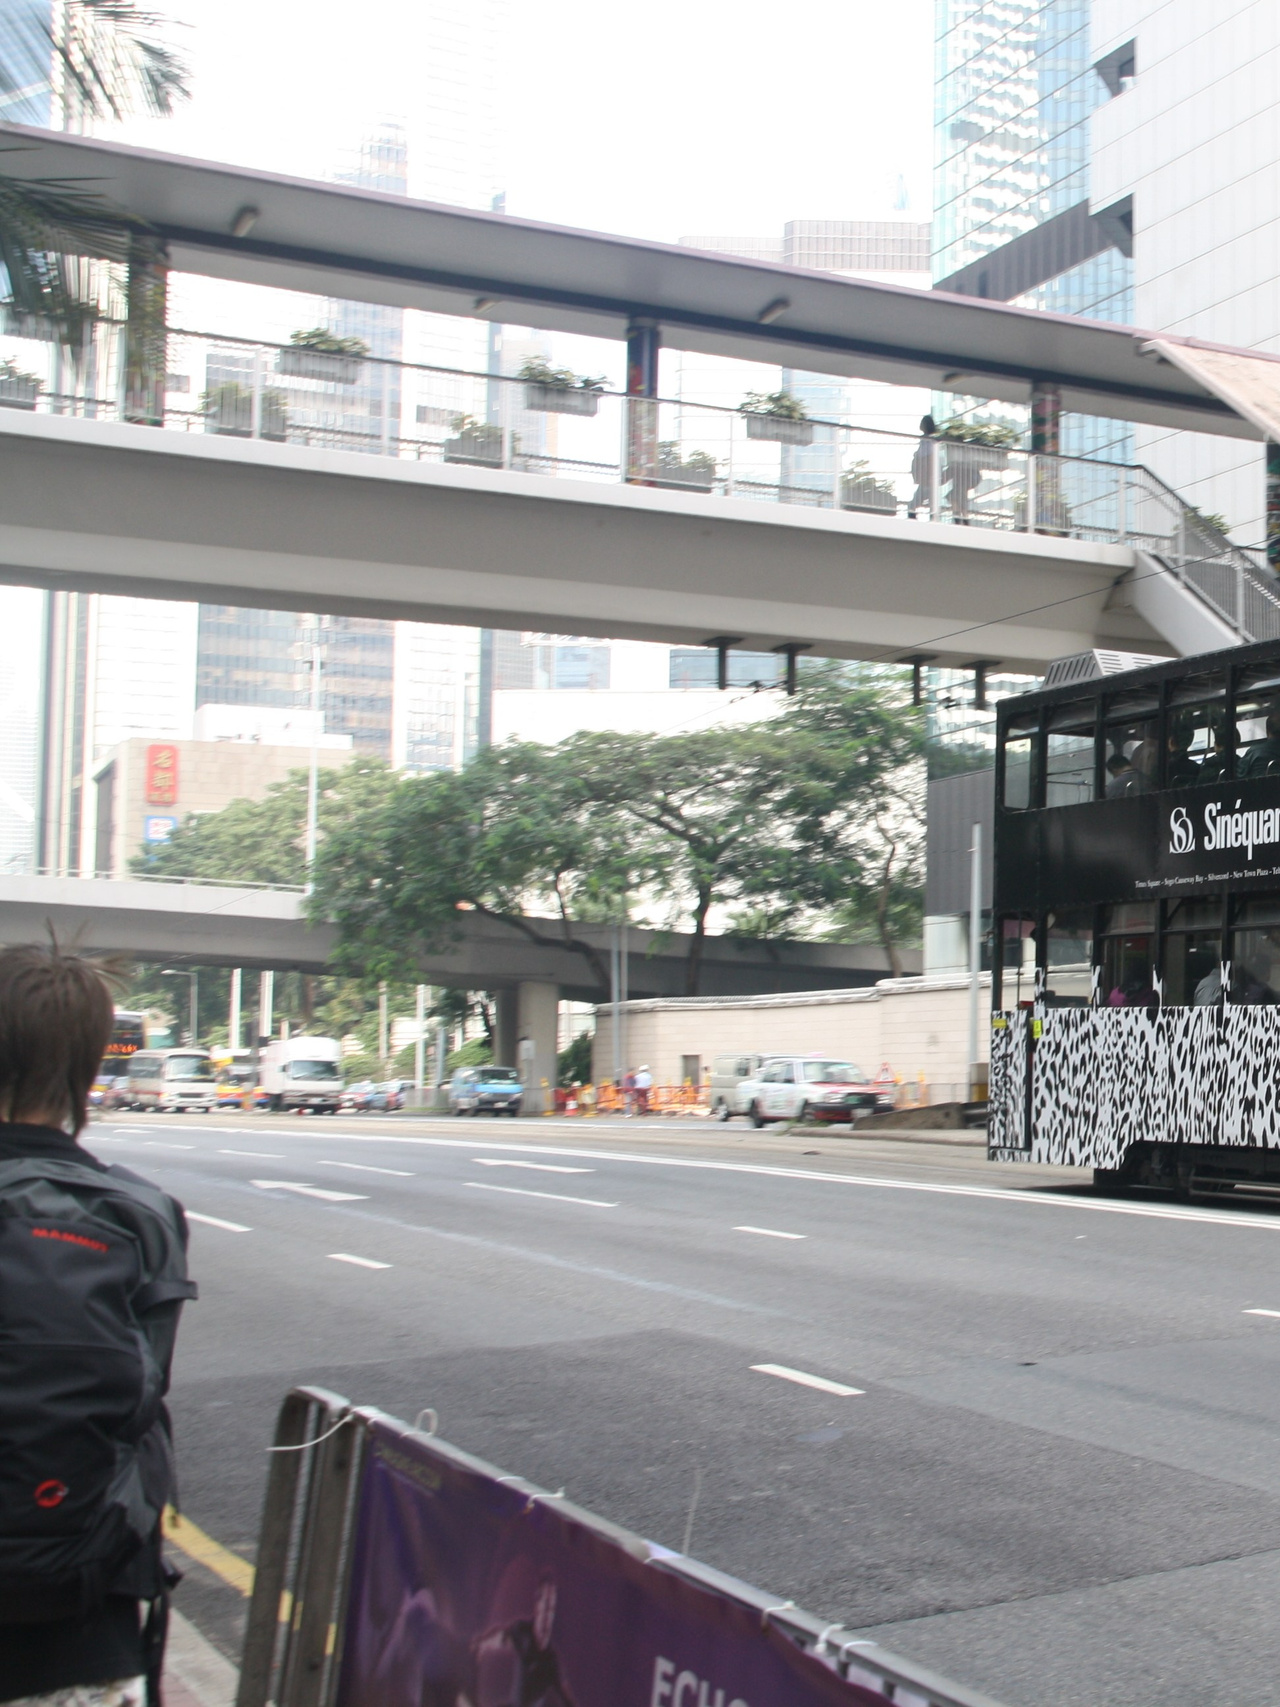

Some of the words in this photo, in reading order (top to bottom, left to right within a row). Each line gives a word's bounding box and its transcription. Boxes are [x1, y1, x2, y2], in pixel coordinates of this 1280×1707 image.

[1233, 870, 1243, 879] New
[1243, 869, 1256, 878] Town
[1256, 868, 1269, 877] Plaza
